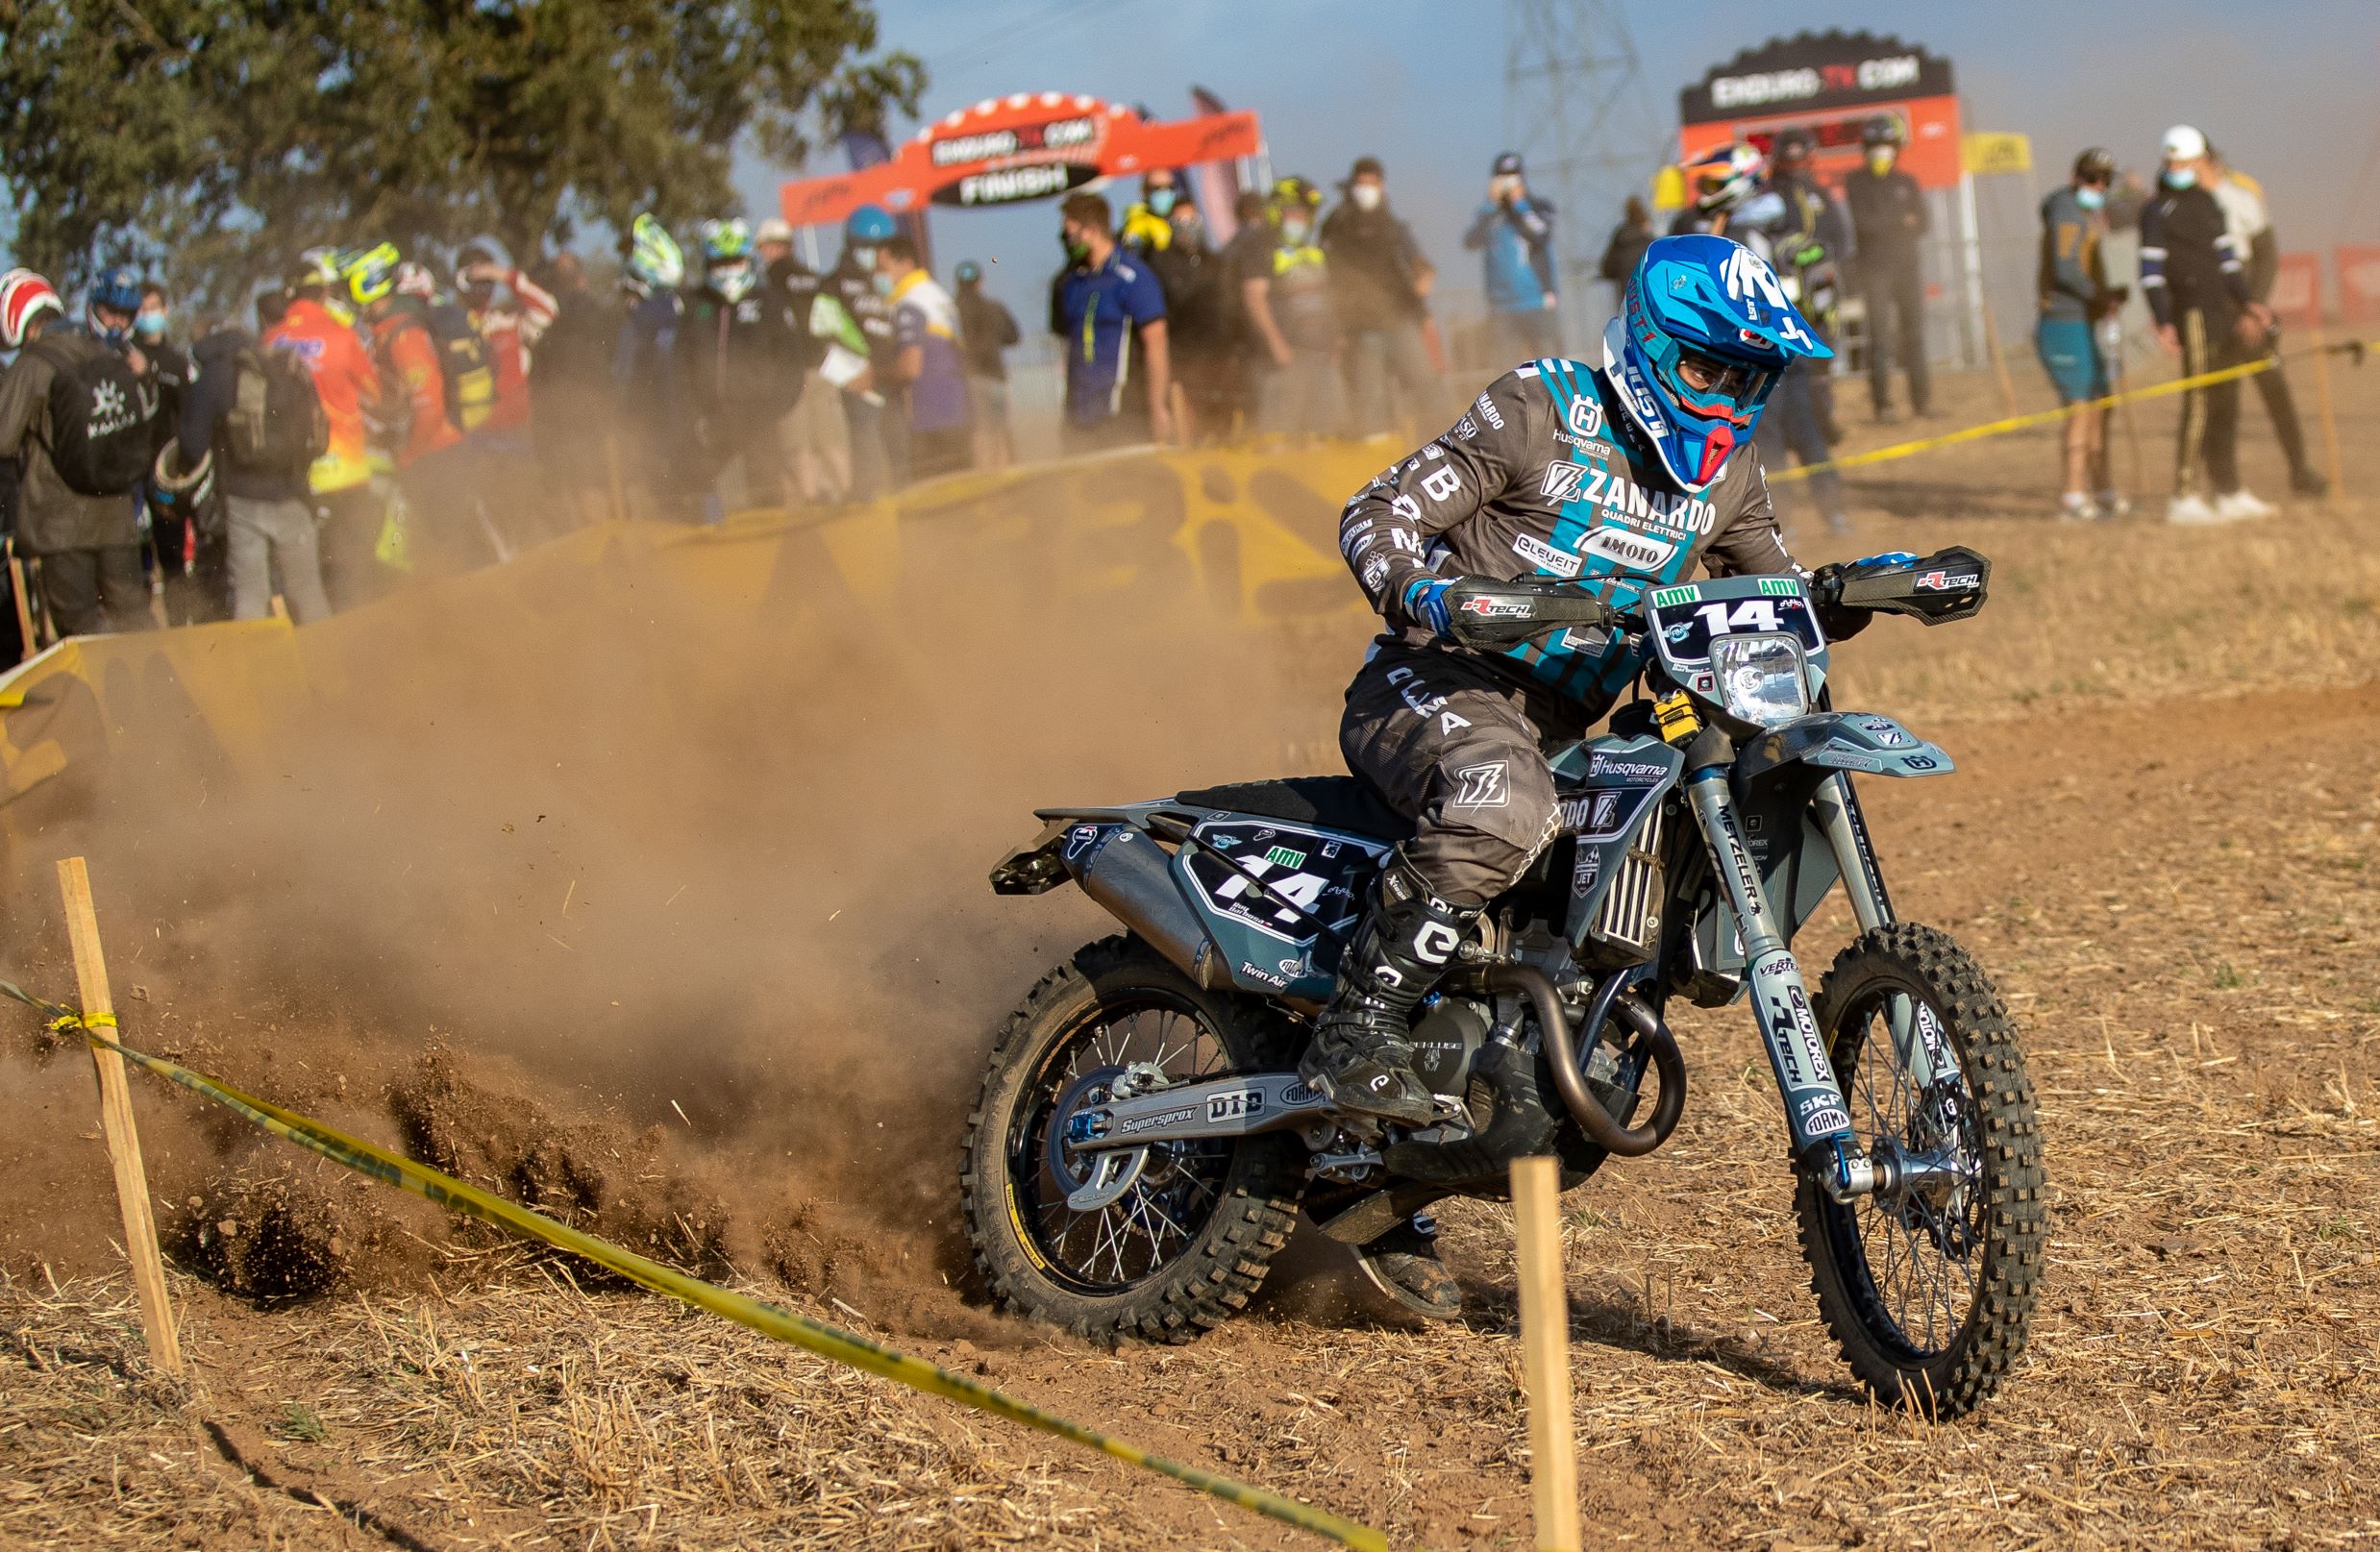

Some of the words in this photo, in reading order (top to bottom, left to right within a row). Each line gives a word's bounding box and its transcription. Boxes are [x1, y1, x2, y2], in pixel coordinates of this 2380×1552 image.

[959, 162, 1069, 206] FINISH
[1552, 429, 1613, 456] Husqvarna
[1582, 467, 1717, 536] ZANARDO
[1601, 508, 1641, 528] QUADRI
[1642, 521, 1687, 541] ELETTRICI
[1695, 600, 1784, 636] 14
[1601, 758, 1669, 776] Husqvarna
[1718, 805, 1758, 899] METZELER
[1577, 873, 1592, 884] JET
[1242, 961, 1269, 983] Twin
[1267, 973, 1288, 988] Air
[1796, 1008, 1832, 1082] MOTOREX
[1799, 1094, 1842, 1117] SKF
[1122, 1109, 1195, 1134] Supersprox
[1808, 1111, 1847, 1133] FORMA
